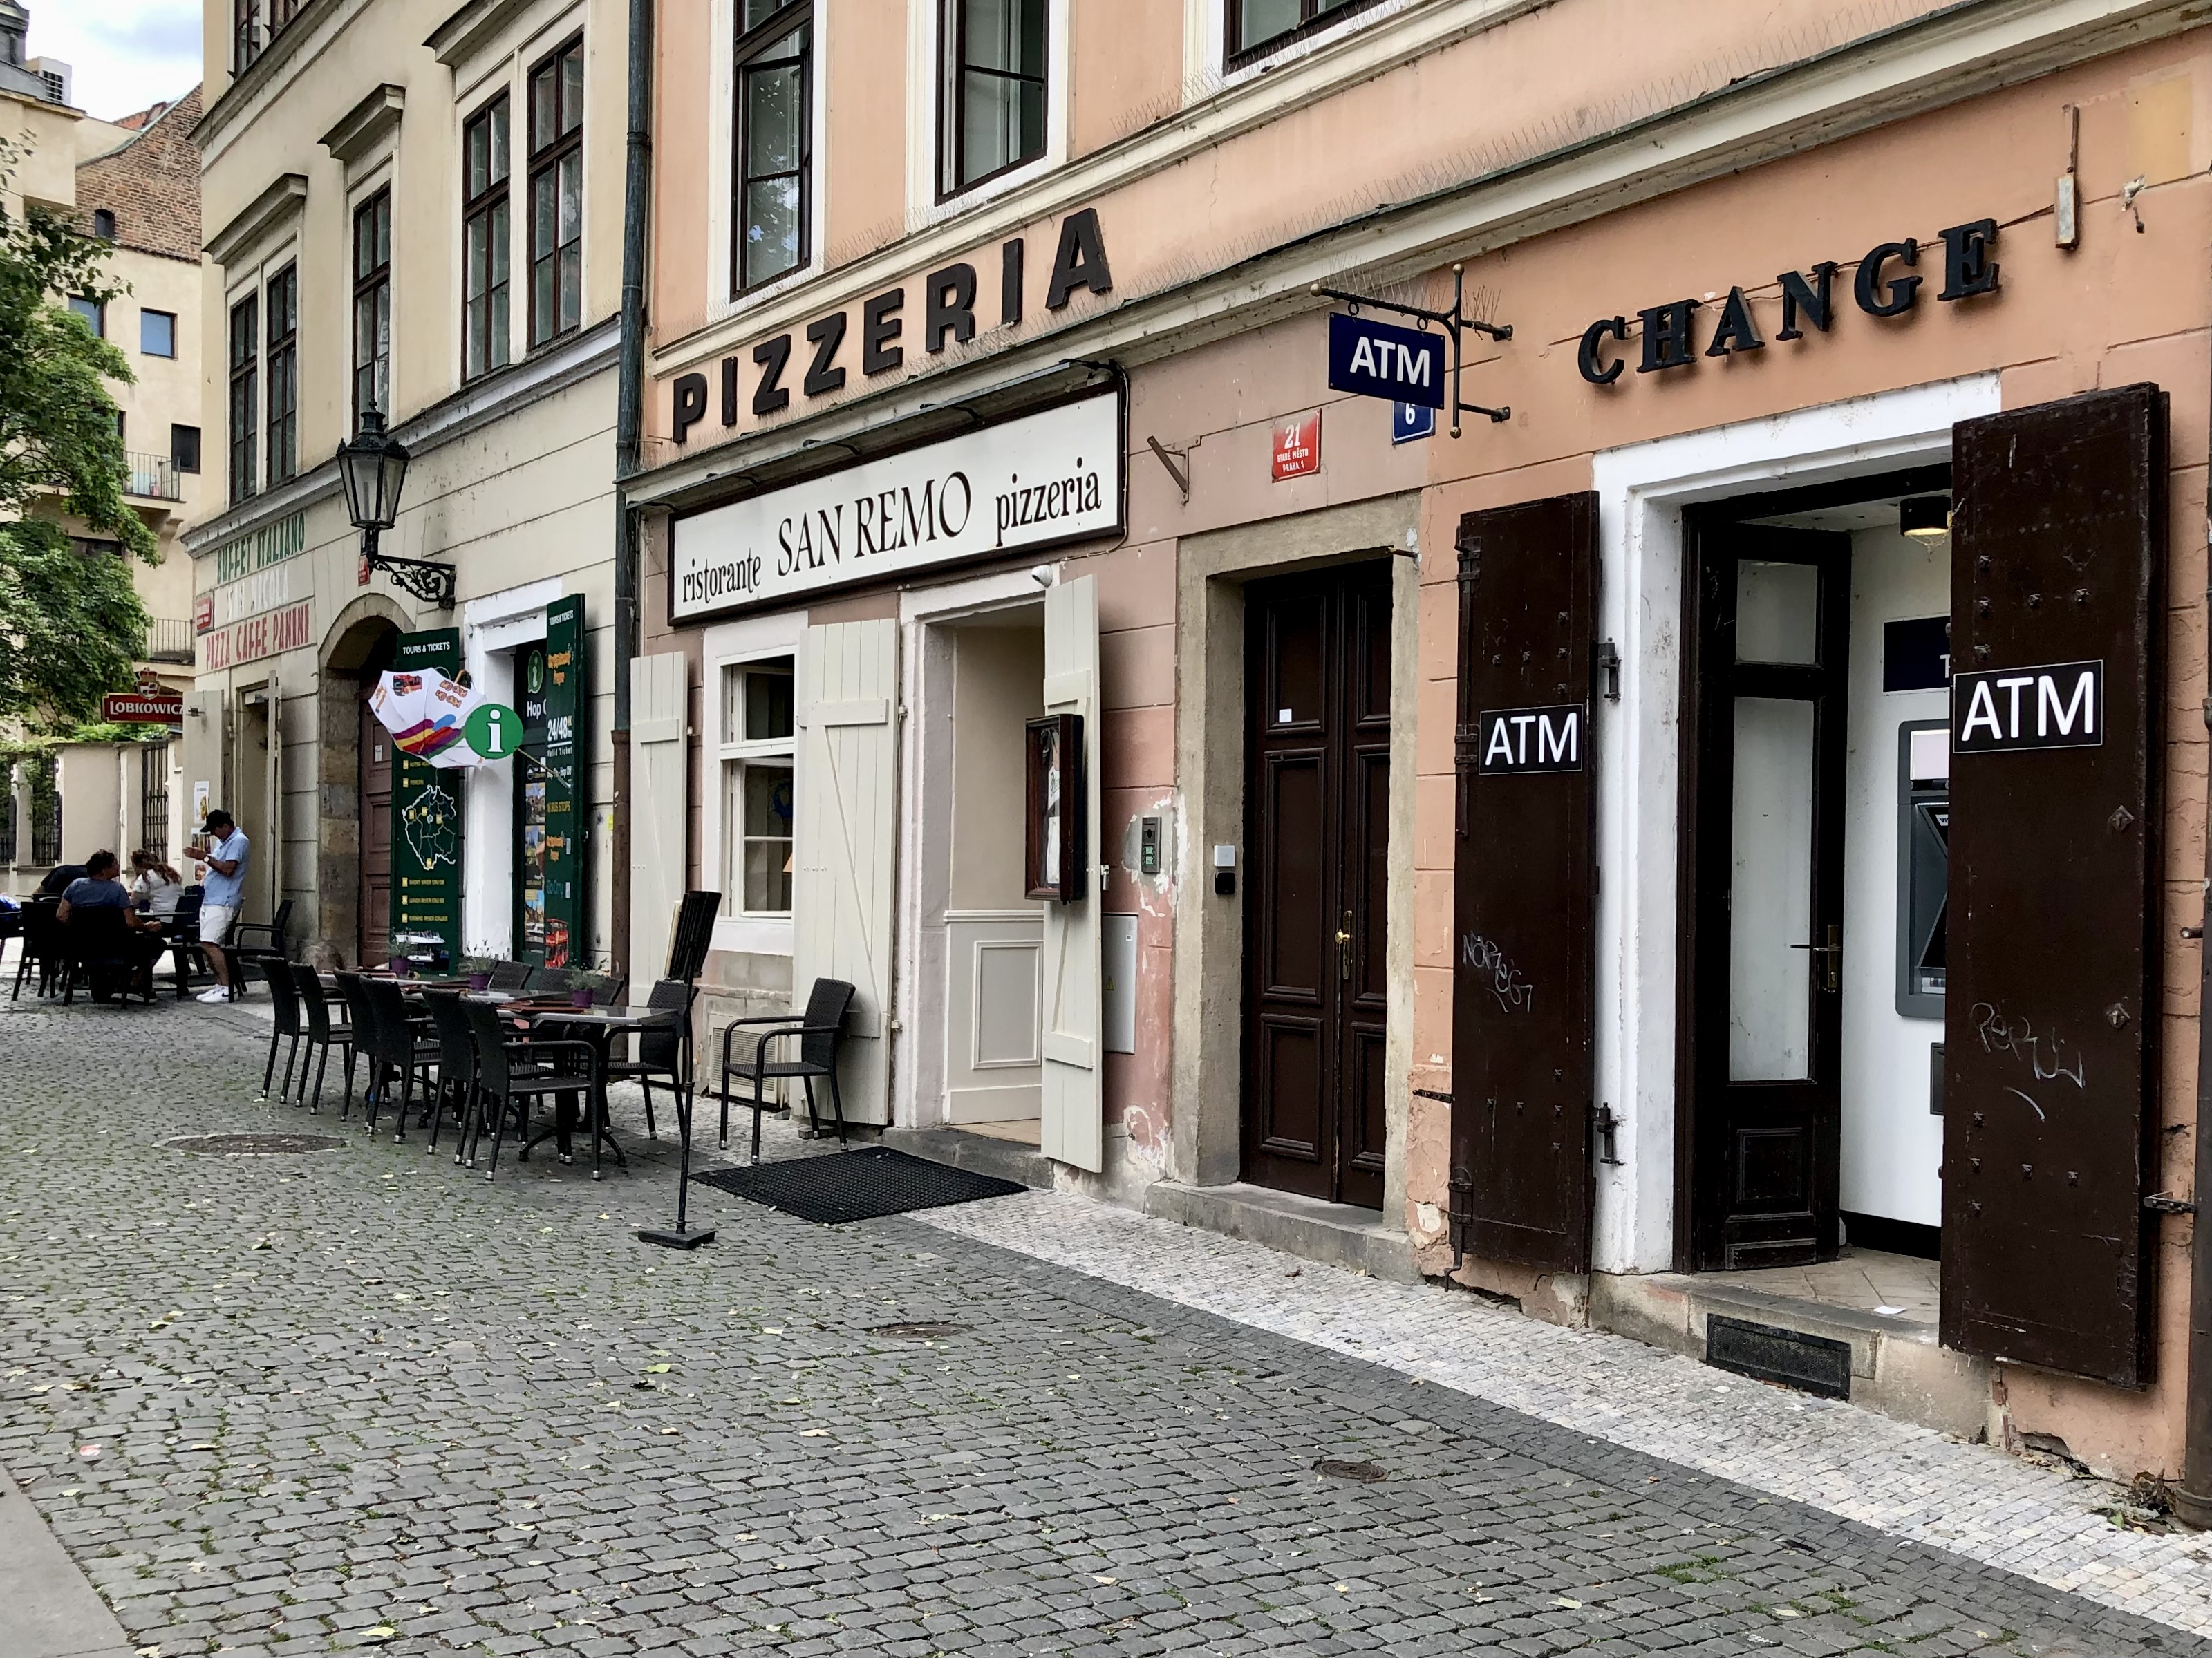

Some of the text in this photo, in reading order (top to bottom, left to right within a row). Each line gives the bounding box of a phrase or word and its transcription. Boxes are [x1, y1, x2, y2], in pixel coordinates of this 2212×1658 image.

[673, 208, 1113, 443] PIZZERIA
[1578, 218, 2000, 384] CHANGE
[1349, 336, 1430, 387] ATM
[1284, 422, 1300, 449] 21
[1405, 403, 1415, 425] 6
[1277, 447, 1309, 463] STARÉ MĚSTO
[1282, 460, 1304, 473] PRAHA 1
[217, 512, 305, 585] BUFFET ITALIANO
[682, 457, 1102, 605] ristorante SAN REMO pizzeria
[206, 630, 230, 671] PIZZA
[272, 603, 310, 652] PANINI
[402, 641, 450, 655] TOURS & TICKETS
[527, 701, 541, 720] Hop
[547, 716, 568, 742] 24/48
[1961, 671, 2094, 742] ATM
[1485, 713, 1577, 766] ATM
